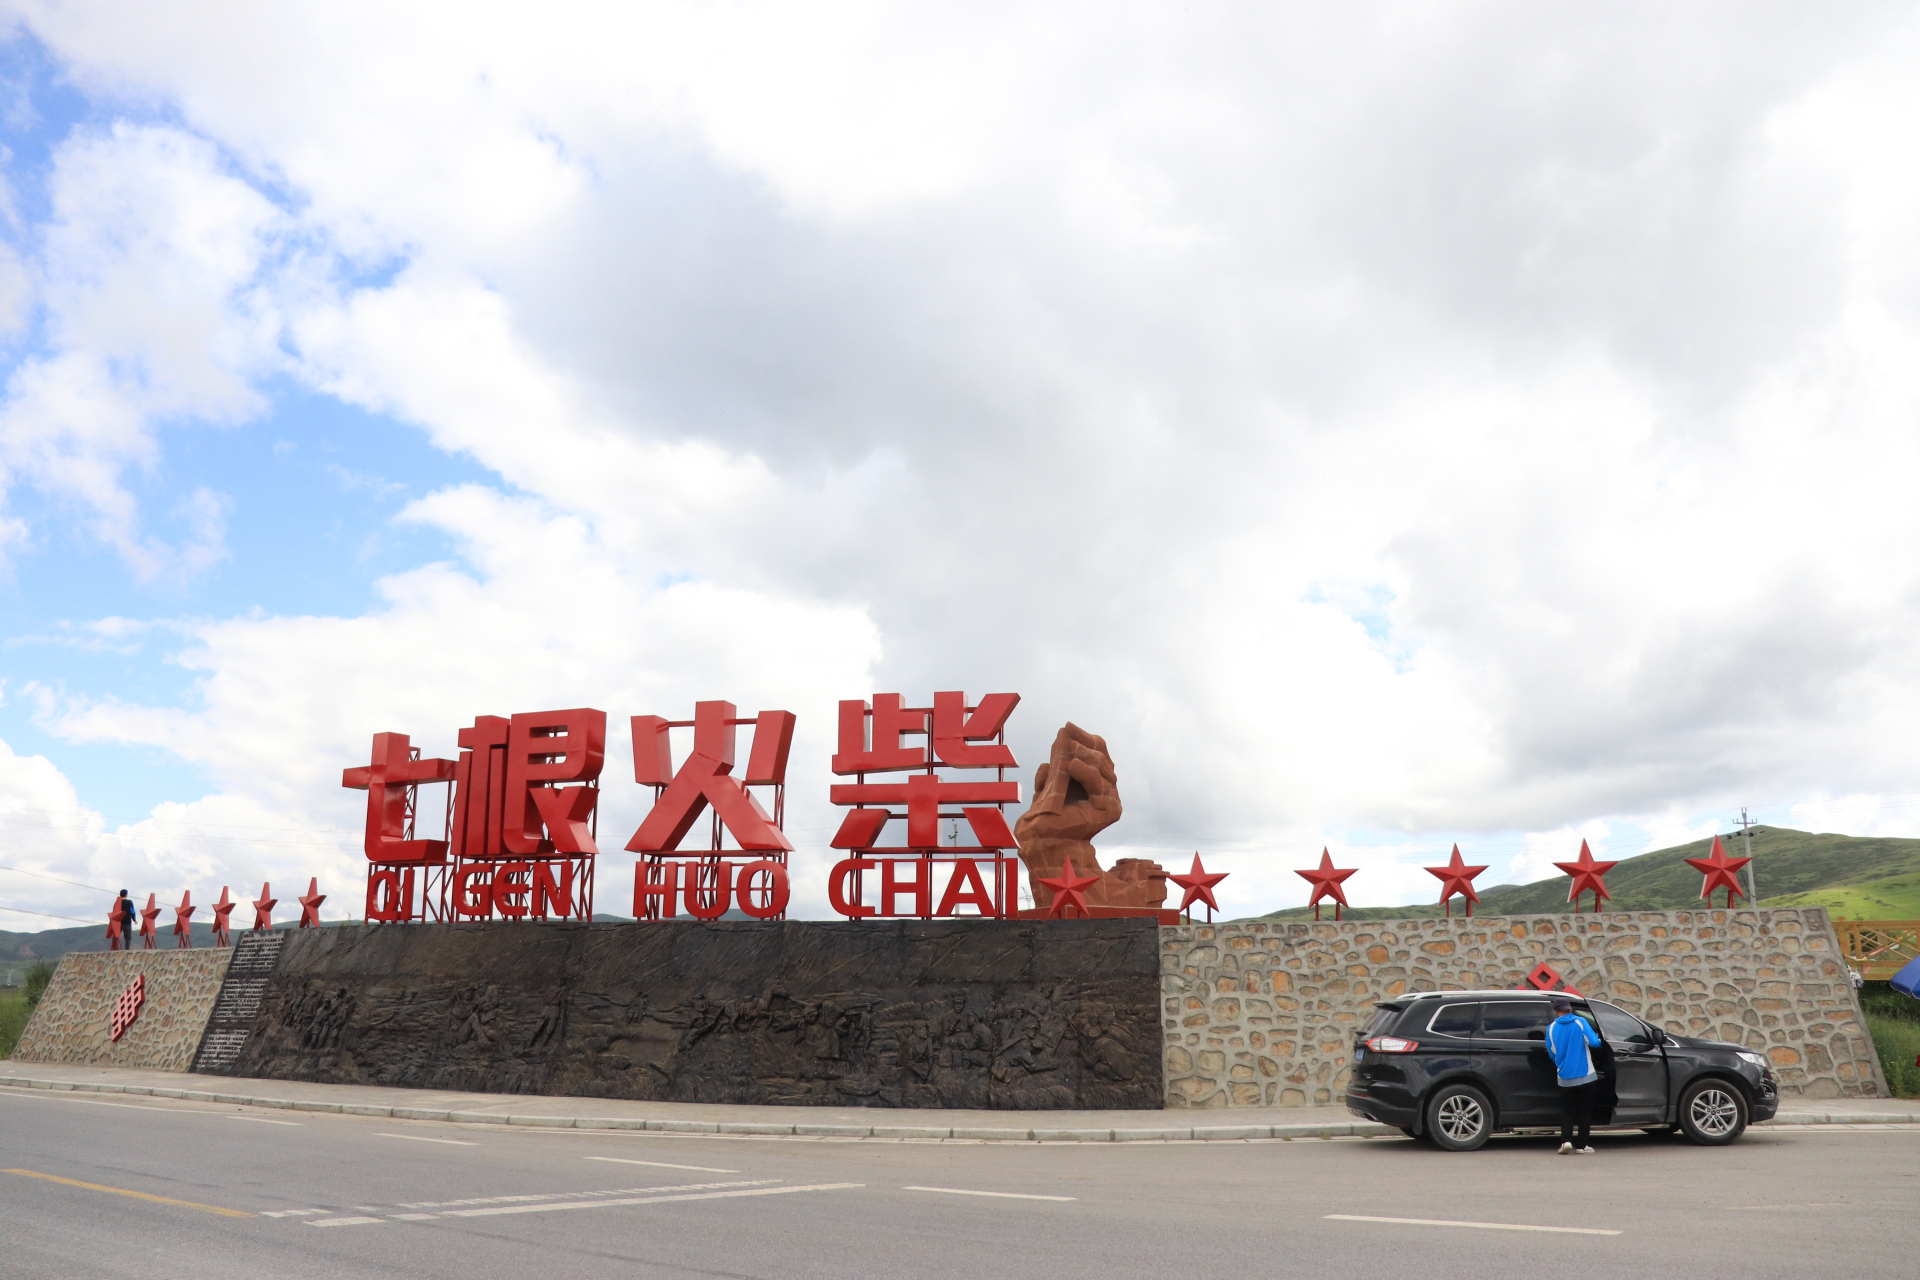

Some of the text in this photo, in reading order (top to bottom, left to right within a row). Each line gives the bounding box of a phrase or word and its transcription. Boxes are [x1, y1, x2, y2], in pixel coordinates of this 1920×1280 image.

[342, 691, 1022, 862] 七根火柴
[366, 858, 1019, 921] QI GEN HUO CHAI
